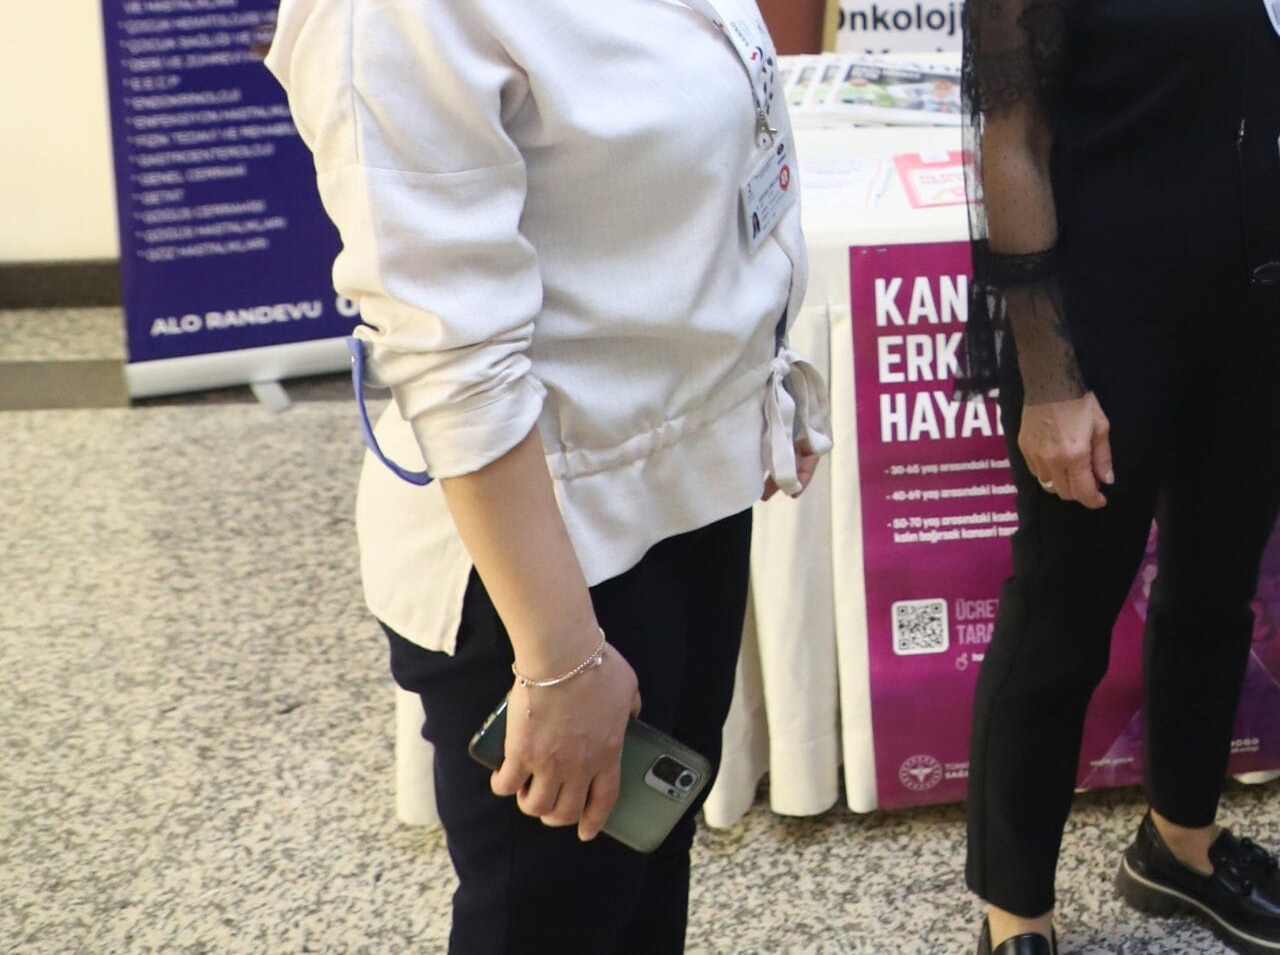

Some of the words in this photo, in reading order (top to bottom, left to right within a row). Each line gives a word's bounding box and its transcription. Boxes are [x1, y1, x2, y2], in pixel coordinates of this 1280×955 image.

[838, 2, 967, 37] nkoloj
[150, 313, 203, 337] ALO
[204, 299, 323, 331] RANDEVU
[874, 274, 969, 327] KAN
